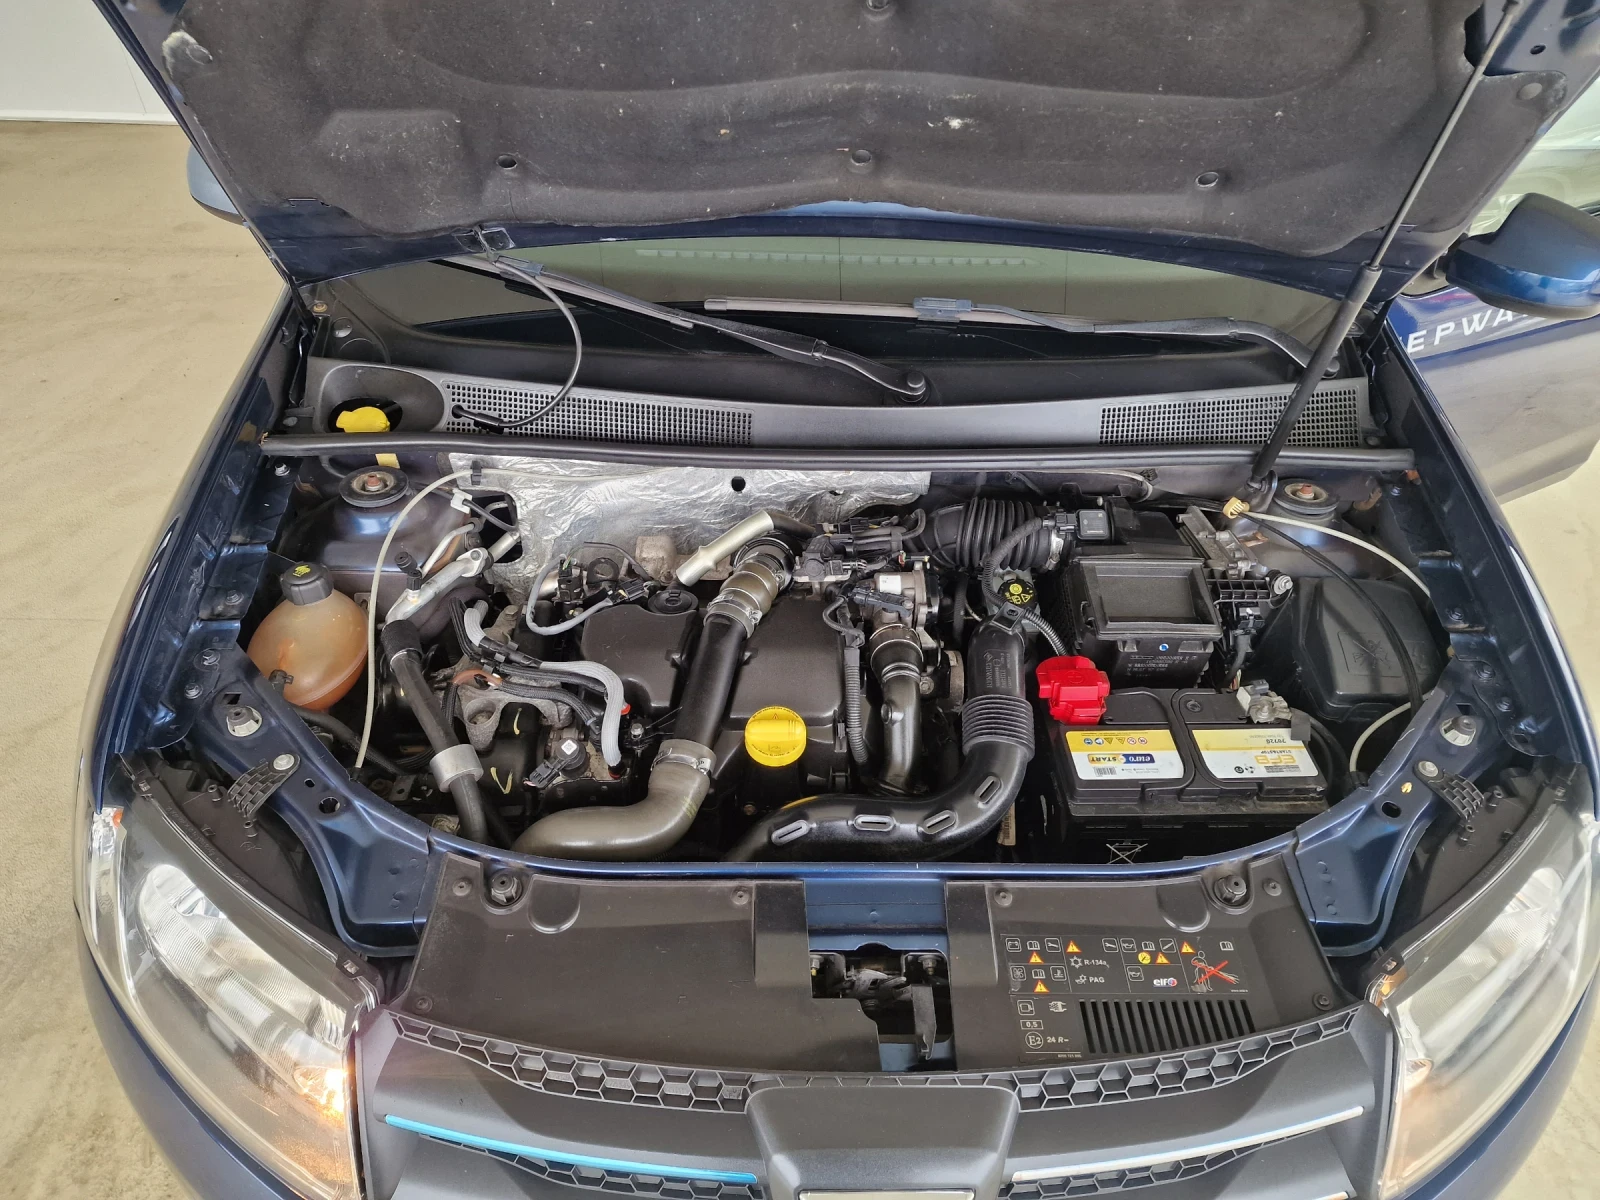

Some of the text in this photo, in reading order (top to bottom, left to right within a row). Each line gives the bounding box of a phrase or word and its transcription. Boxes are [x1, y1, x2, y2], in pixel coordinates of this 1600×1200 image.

[1400, 309, 1528, 353] EPWA
[1128, 755, 1151, 763] euro
[1254, 754, 1296, 764] EFB
[1153, 978, 1168, 986] elf
[1028, 1035, 1041, 1046] E2
